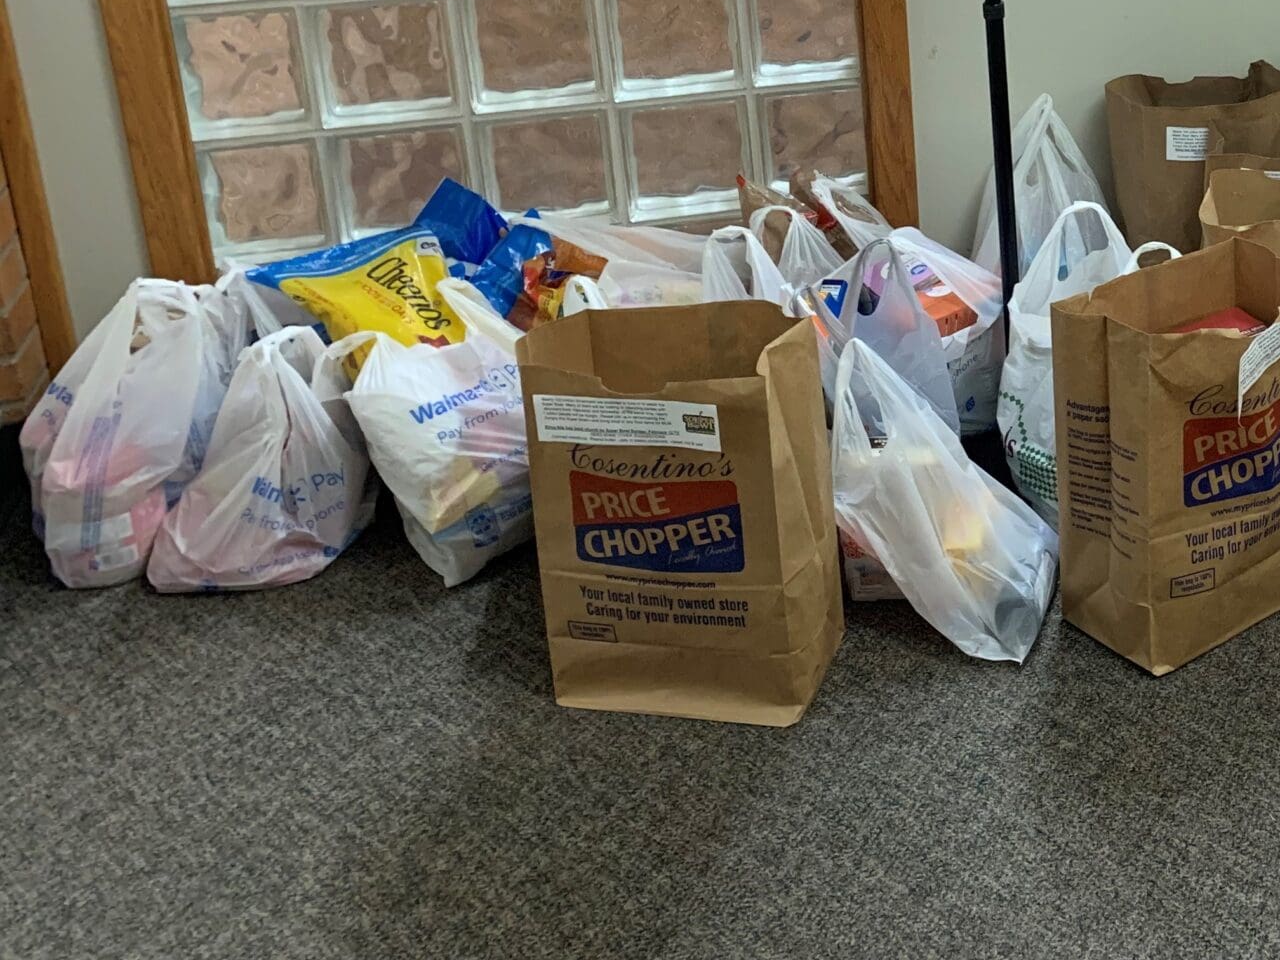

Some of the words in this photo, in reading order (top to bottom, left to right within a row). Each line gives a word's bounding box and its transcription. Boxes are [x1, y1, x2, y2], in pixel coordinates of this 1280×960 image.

[365, 256, 452, 332] Cheerios
[436, 424, 463, 445] Pay
[464, 407, 499, 430] from
[1072, 411, 1093, 423] paper
[1193, 407, 1278, 462] PRICE
[311, 463, 345, 491] Pay
[567, 444, 735, 478] Cosentino's
[581, 486, 671, 519] PRICE
[583, 513, 737, 558] CHOPPER
[1185, 530, 1209, 548] Your
[1212, 521, 1237, 542] local
[1240, 511, 1270, 534] family
[1191, 544, 1225, 565] Caring
[1227, 538, 1242, 554] for
[1242, 530, 1263, 553] your
[579, 584, 605, 602] Your
[608, 587, 635, 605] local
[637, 592, 674, 611] family
[677, 596, 716, 611] owned
[718, 597, 749, 612] store
[586, 602, 624, 622] Caring
[626, 605, 641, 620] for
[644, 610, 670, 624] your
[673, 611, 747, 628] environment
